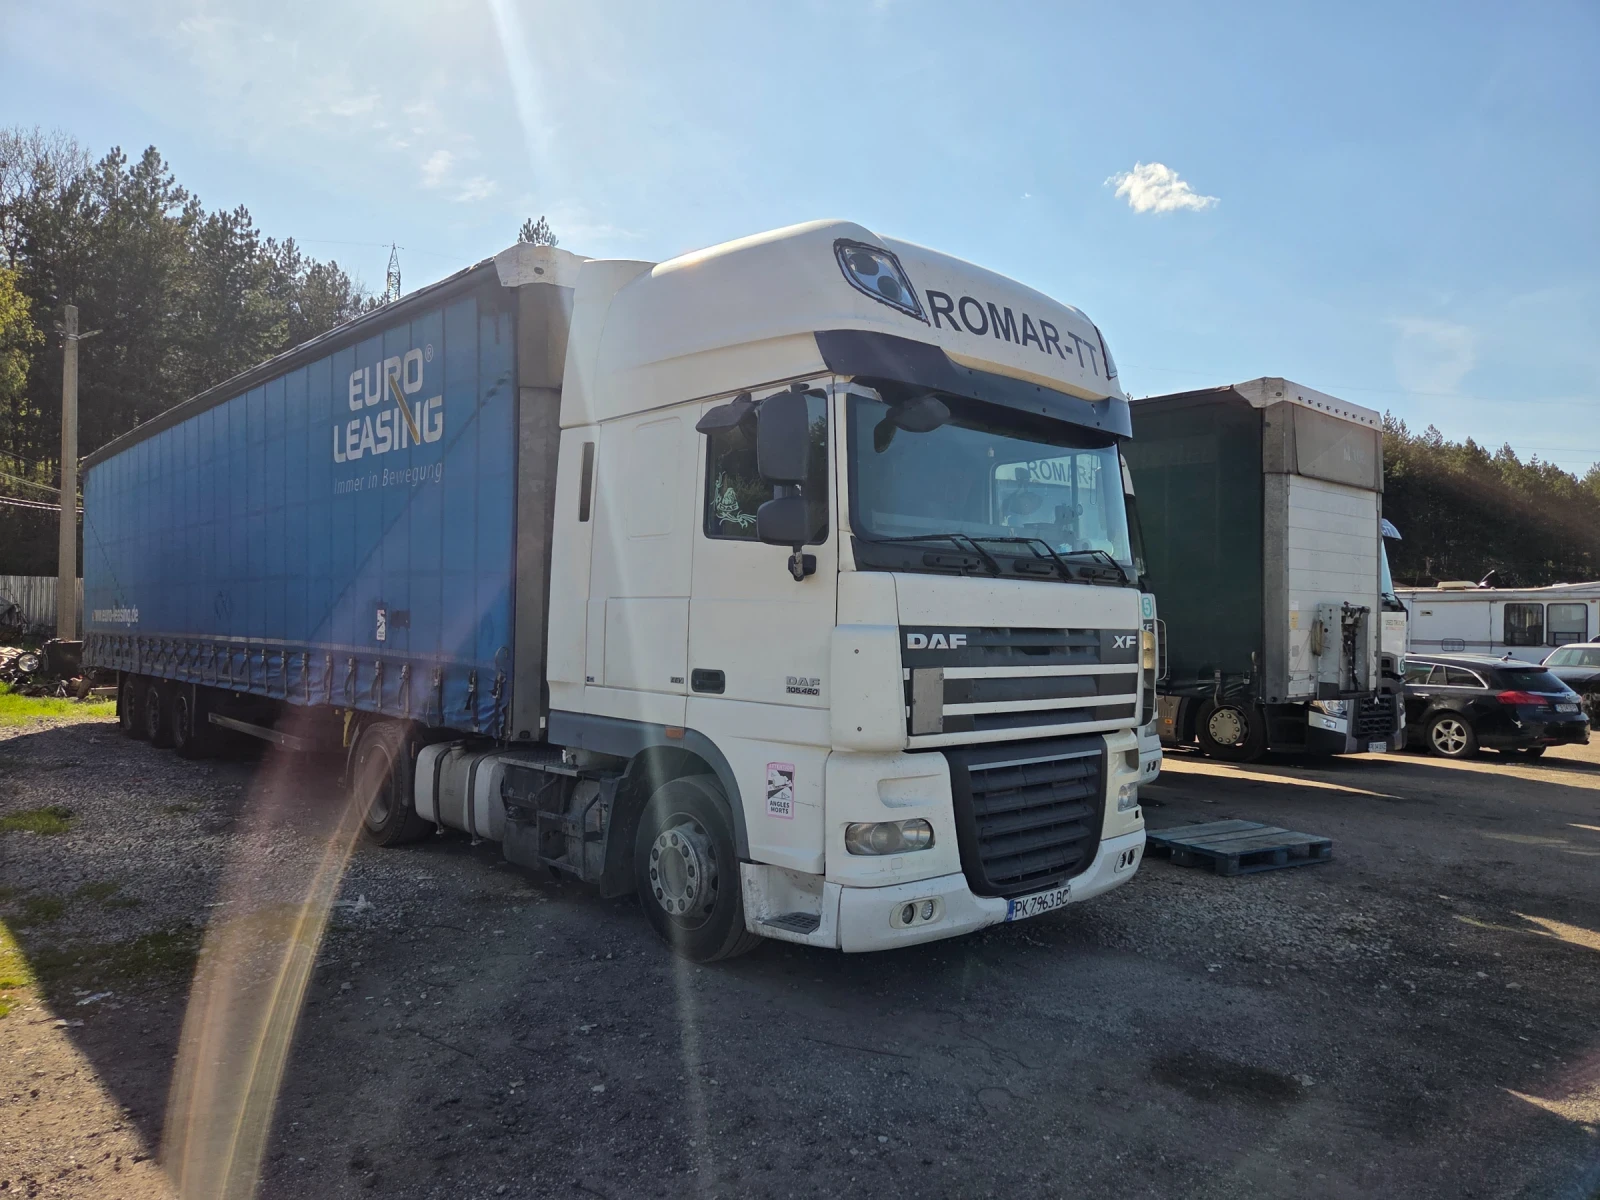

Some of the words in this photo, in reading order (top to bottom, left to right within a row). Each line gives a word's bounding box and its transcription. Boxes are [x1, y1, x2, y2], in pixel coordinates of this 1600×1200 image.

[925, 289, 1099, 377] ROMAR-TT
[349, 347, 424, 412] EURO
[333, 394, 444, 464] LEASING
[334, 476, 365, 494] Immer
[368, 470, 378, 489] in
[382, 463, 442, 486] Bewegung
[906, 633, 967, 650] DAF
[1111, 635, 1137, 649] XF
[786, 676, 821, 687] DAF
[770, 800, 790, 809] ANGLES
[770, 807, 789, 815] MORTS
